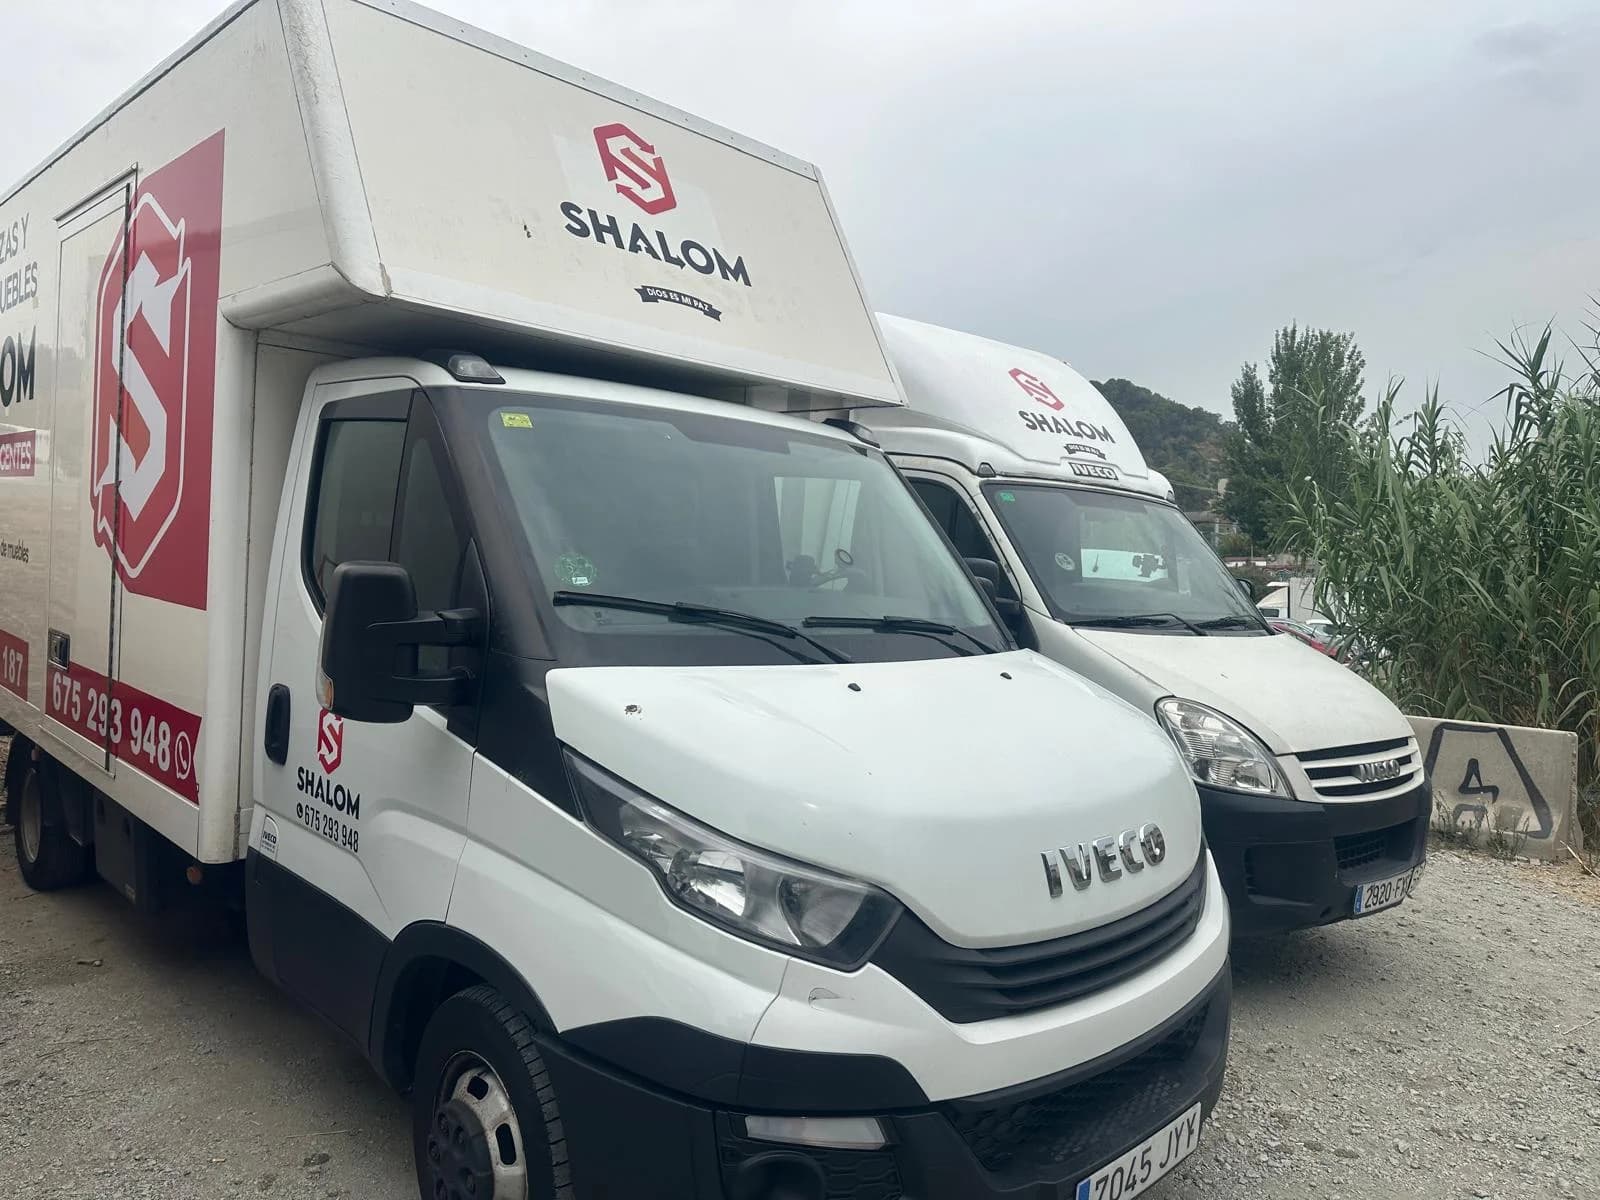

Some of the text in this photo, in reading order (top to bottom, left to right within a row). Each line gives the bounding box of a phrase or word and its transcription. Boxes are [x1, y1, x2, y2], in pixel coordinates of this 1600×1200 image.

[21, 212, 29, 249] Y
[560, 201, 752, 287] SHALOM
[646, 287, 709, 311] DIOS ES MI PAZ
[0, 325, 36, 407] OM
[1018, 410, 1116, 444] SHALOM
[1071, 463, 1116, 479] IVECO
[8, 538, 29, 563] muebles
[2, 646, 23, 687] 187
[53, 671, 171, 772] 675 293 948
[1359, 759, 1400, 782] IVECO
[296, 766, 361, 820] SHALOM
[262, 830, 277, 845] IVECO
[304, 804, 359, 853] 675 293 948
[1040, 822, 1165, 898] IVECO
[1095, 1111, 1197, 1200] 7045 JYY
